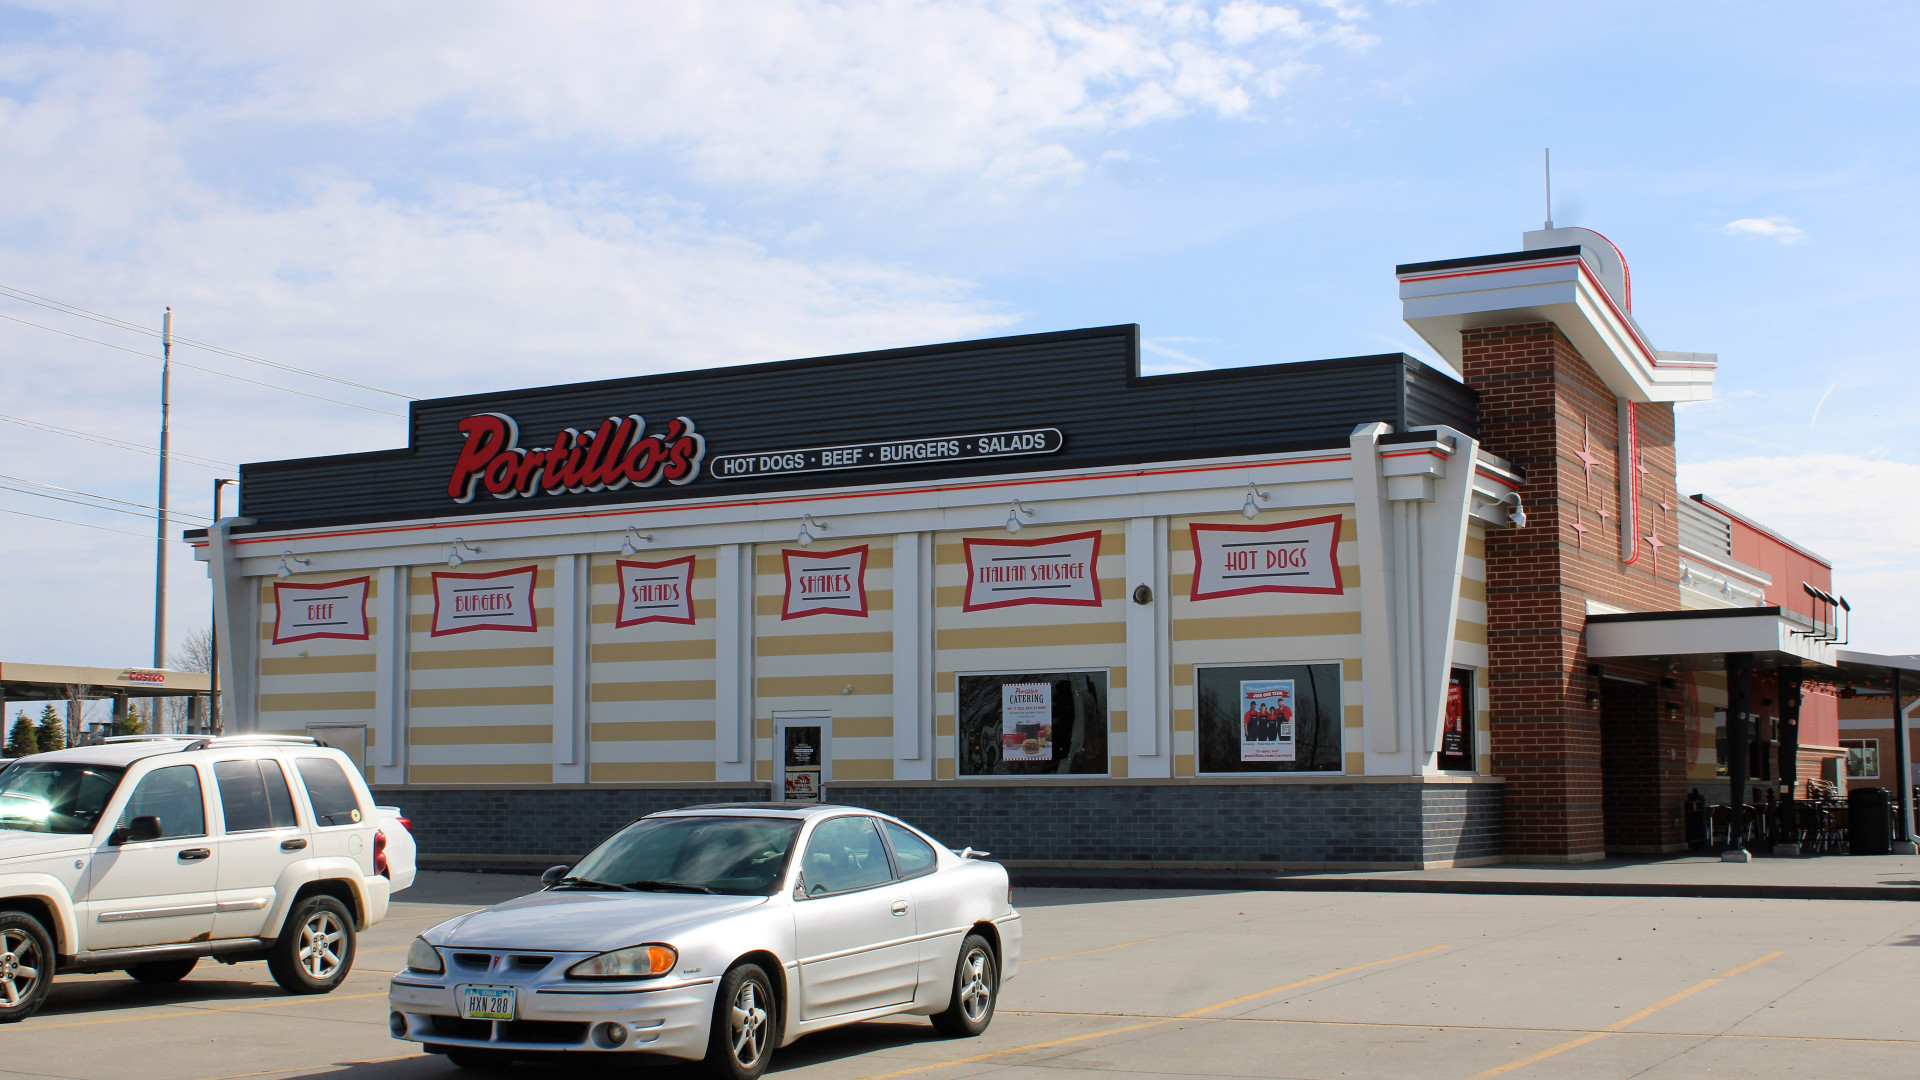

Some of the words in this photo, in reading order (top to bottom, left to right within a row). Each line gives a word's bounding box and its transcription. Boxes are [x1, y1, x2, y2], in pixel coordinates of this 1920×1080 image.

[448, 413, 704, 502] Portillo's
[724, 456, 756, 474] HOT
[760, 454, 805, 472] DOGS
[821, 448, 863, 466] BEEF
[880, 440, 960, 462] BURGERS
[978, 433, 1046, 453] SALADS
[1224, 548, 1258, 571] HOT
[1266, 547, 1307, 570] DOGS
[979, 564, 1027, 583] ITALIAN
[1030, 562, 1085, 582] SAUSAGE
[631, 583, 680, 603] SALADS
[800, 573, 851, 594] SHAKES
[307, 603, 334, 621] BEEF
[455, 592, 513, 612] BURGERS
[1009, 694, 1044, 704] CATERING
[470, 996, 488, 1012] HXN
[490, 997, 508, 1013] 288
